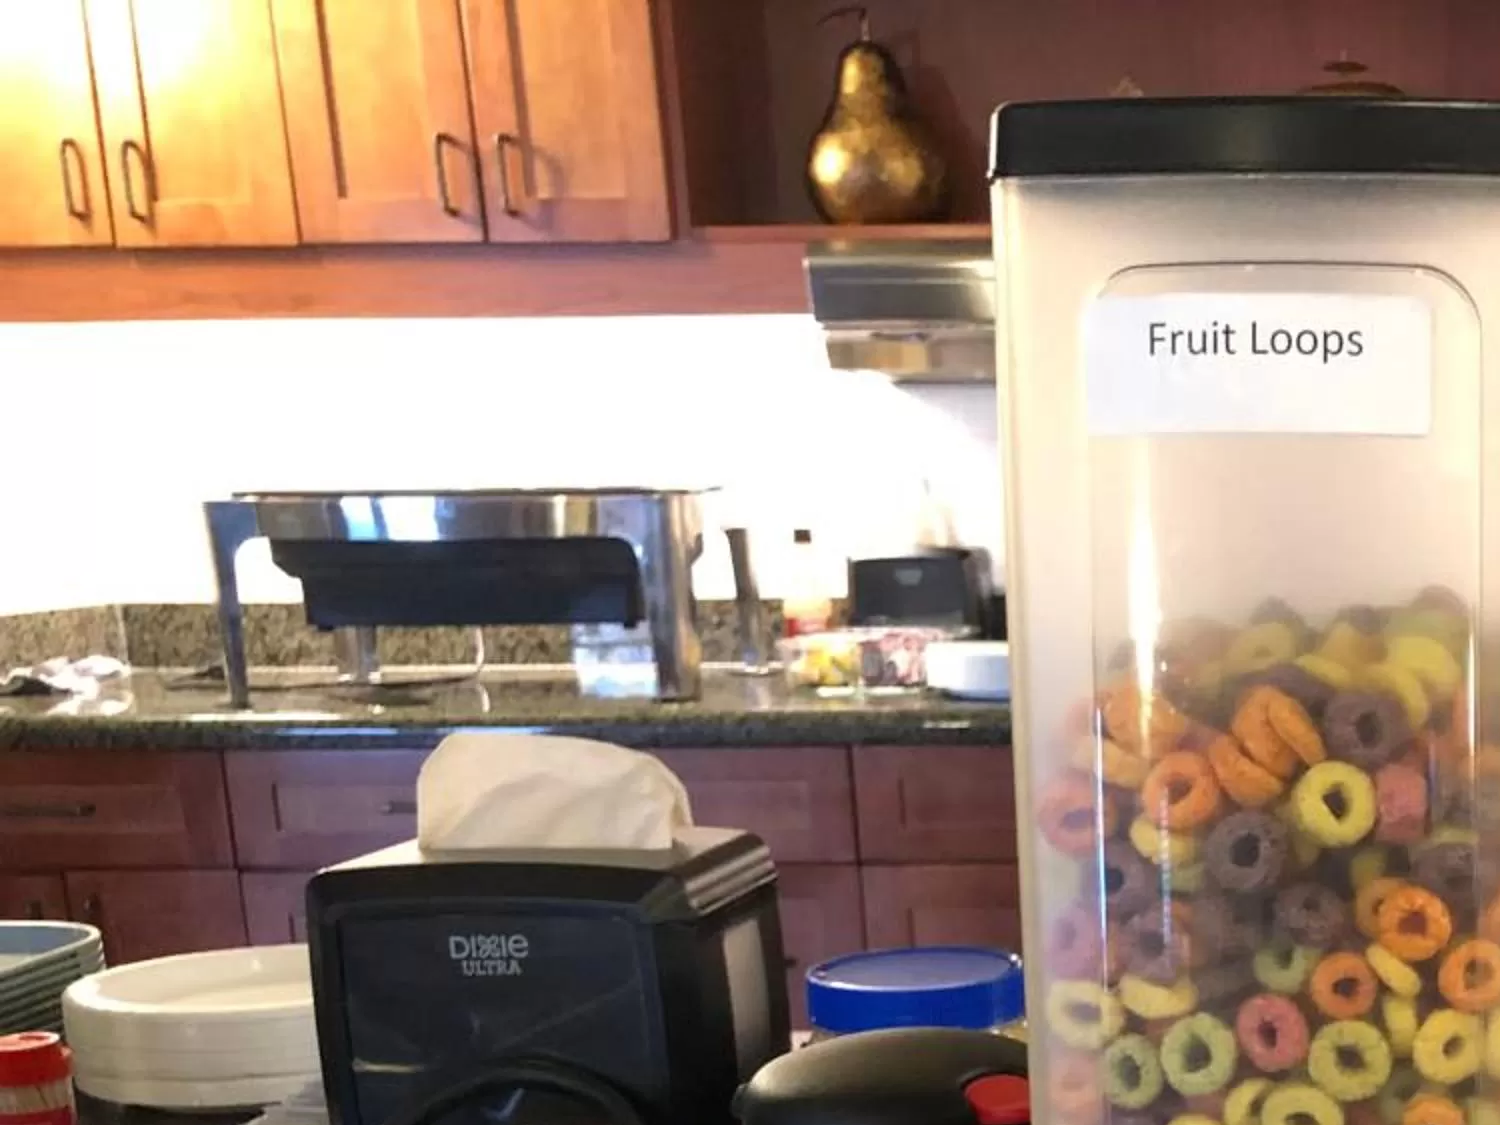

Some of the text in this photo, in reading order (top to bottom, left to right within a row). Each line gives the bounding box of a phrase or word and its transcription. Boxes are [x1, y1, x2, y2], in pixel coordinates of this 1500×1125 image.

[1149, 320, 1364, 364] Fruit Loops
[461, 959, 523, 976] ULTRA
